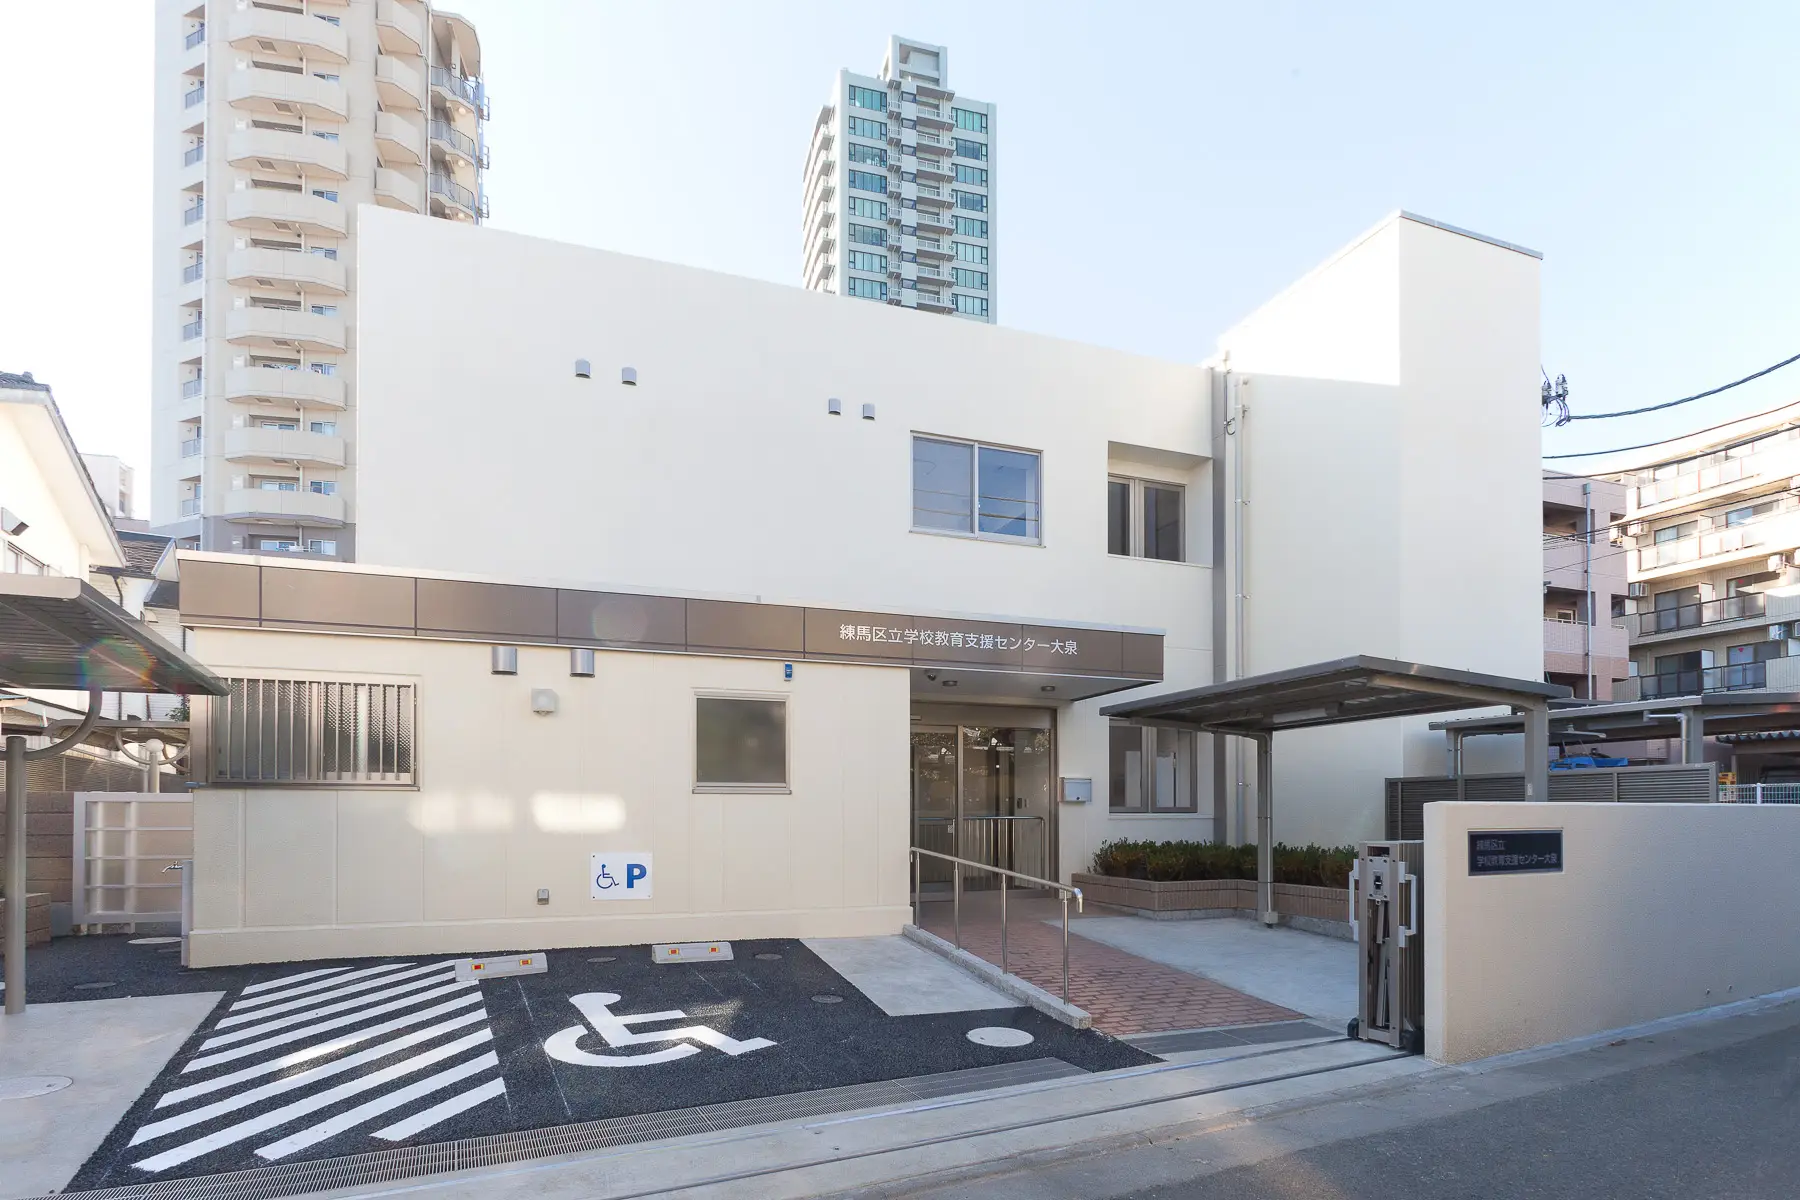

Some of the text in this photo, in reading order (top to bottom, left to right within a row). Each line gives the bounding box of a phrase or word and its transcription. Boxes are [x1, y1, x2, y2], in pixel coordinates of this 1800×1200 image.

[839, 623, 1078, 655] 練馬区立学校教育支援センター大泉
[626, 863, 647, 889] P
